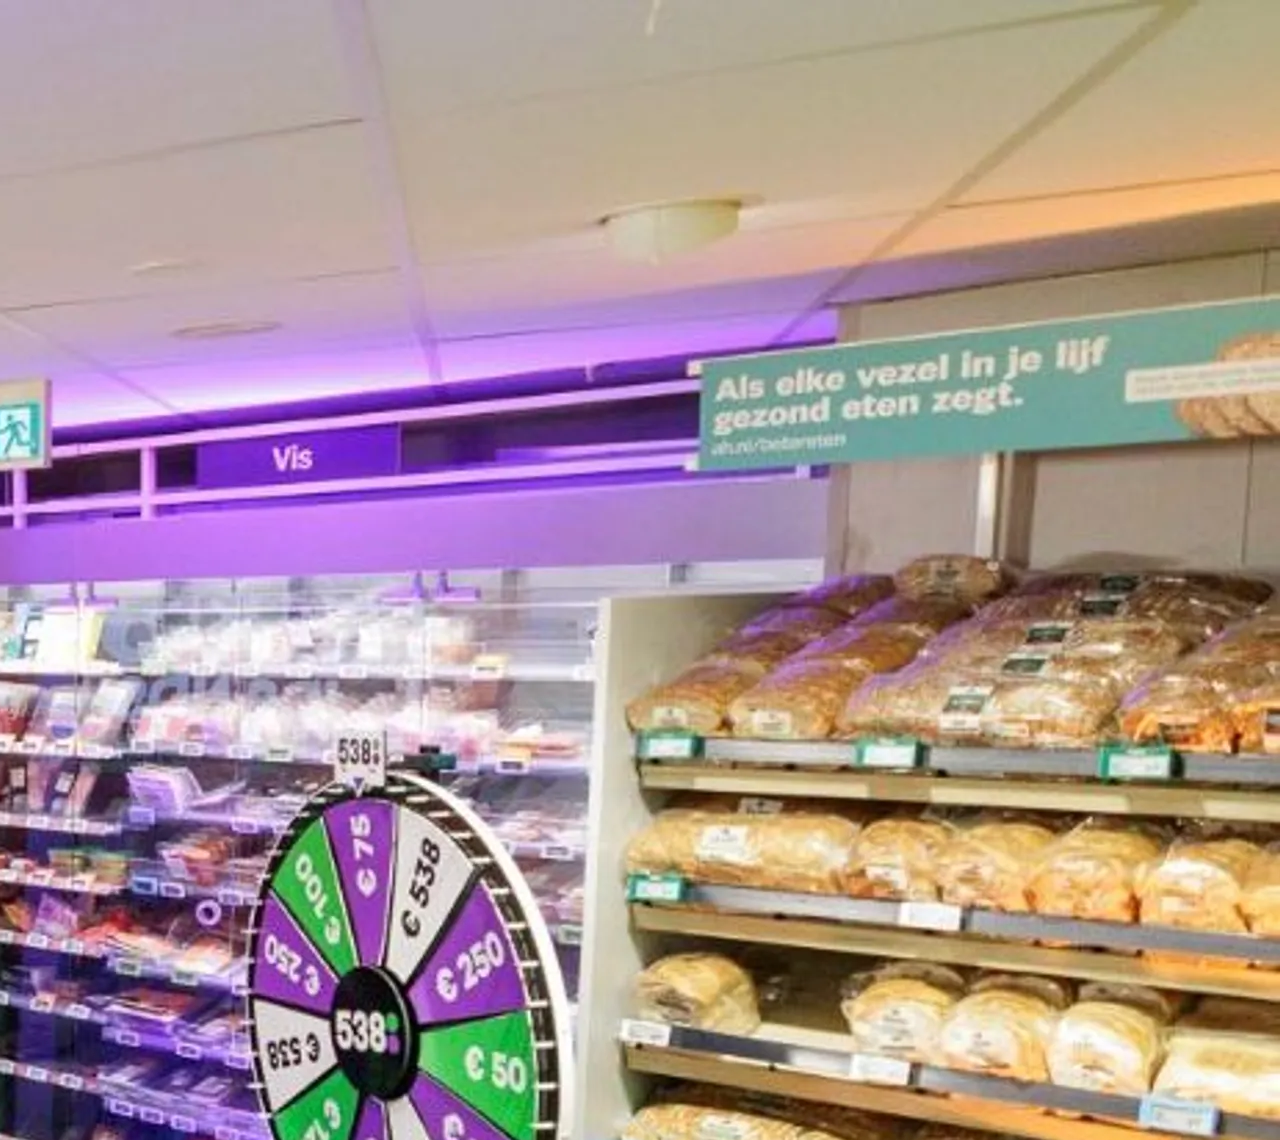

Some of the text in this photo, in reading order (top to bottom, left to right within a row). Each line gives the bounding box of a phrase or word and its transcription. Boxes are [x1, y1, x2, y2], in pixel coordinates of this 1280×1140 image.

[714, 335, 1111, 402] Als elke vezel in je lijf
[712, 380, 1024, 436] gezond eten zegt.
[272, 445, 314, 471] Vis
[339, 738, 371, 765] 538
[351, 814, 372, 861] 75
[295, 853, 329, 919] 100
[408, 837, 442, 909] 538
[263, 933, 302, 983] 250
[456, 932, 505, 992] 250
[267, 1037, 301, 1070] 538
[336, 1008, 387, 1052] 538
[490, 1052, 527, 1094] 50
